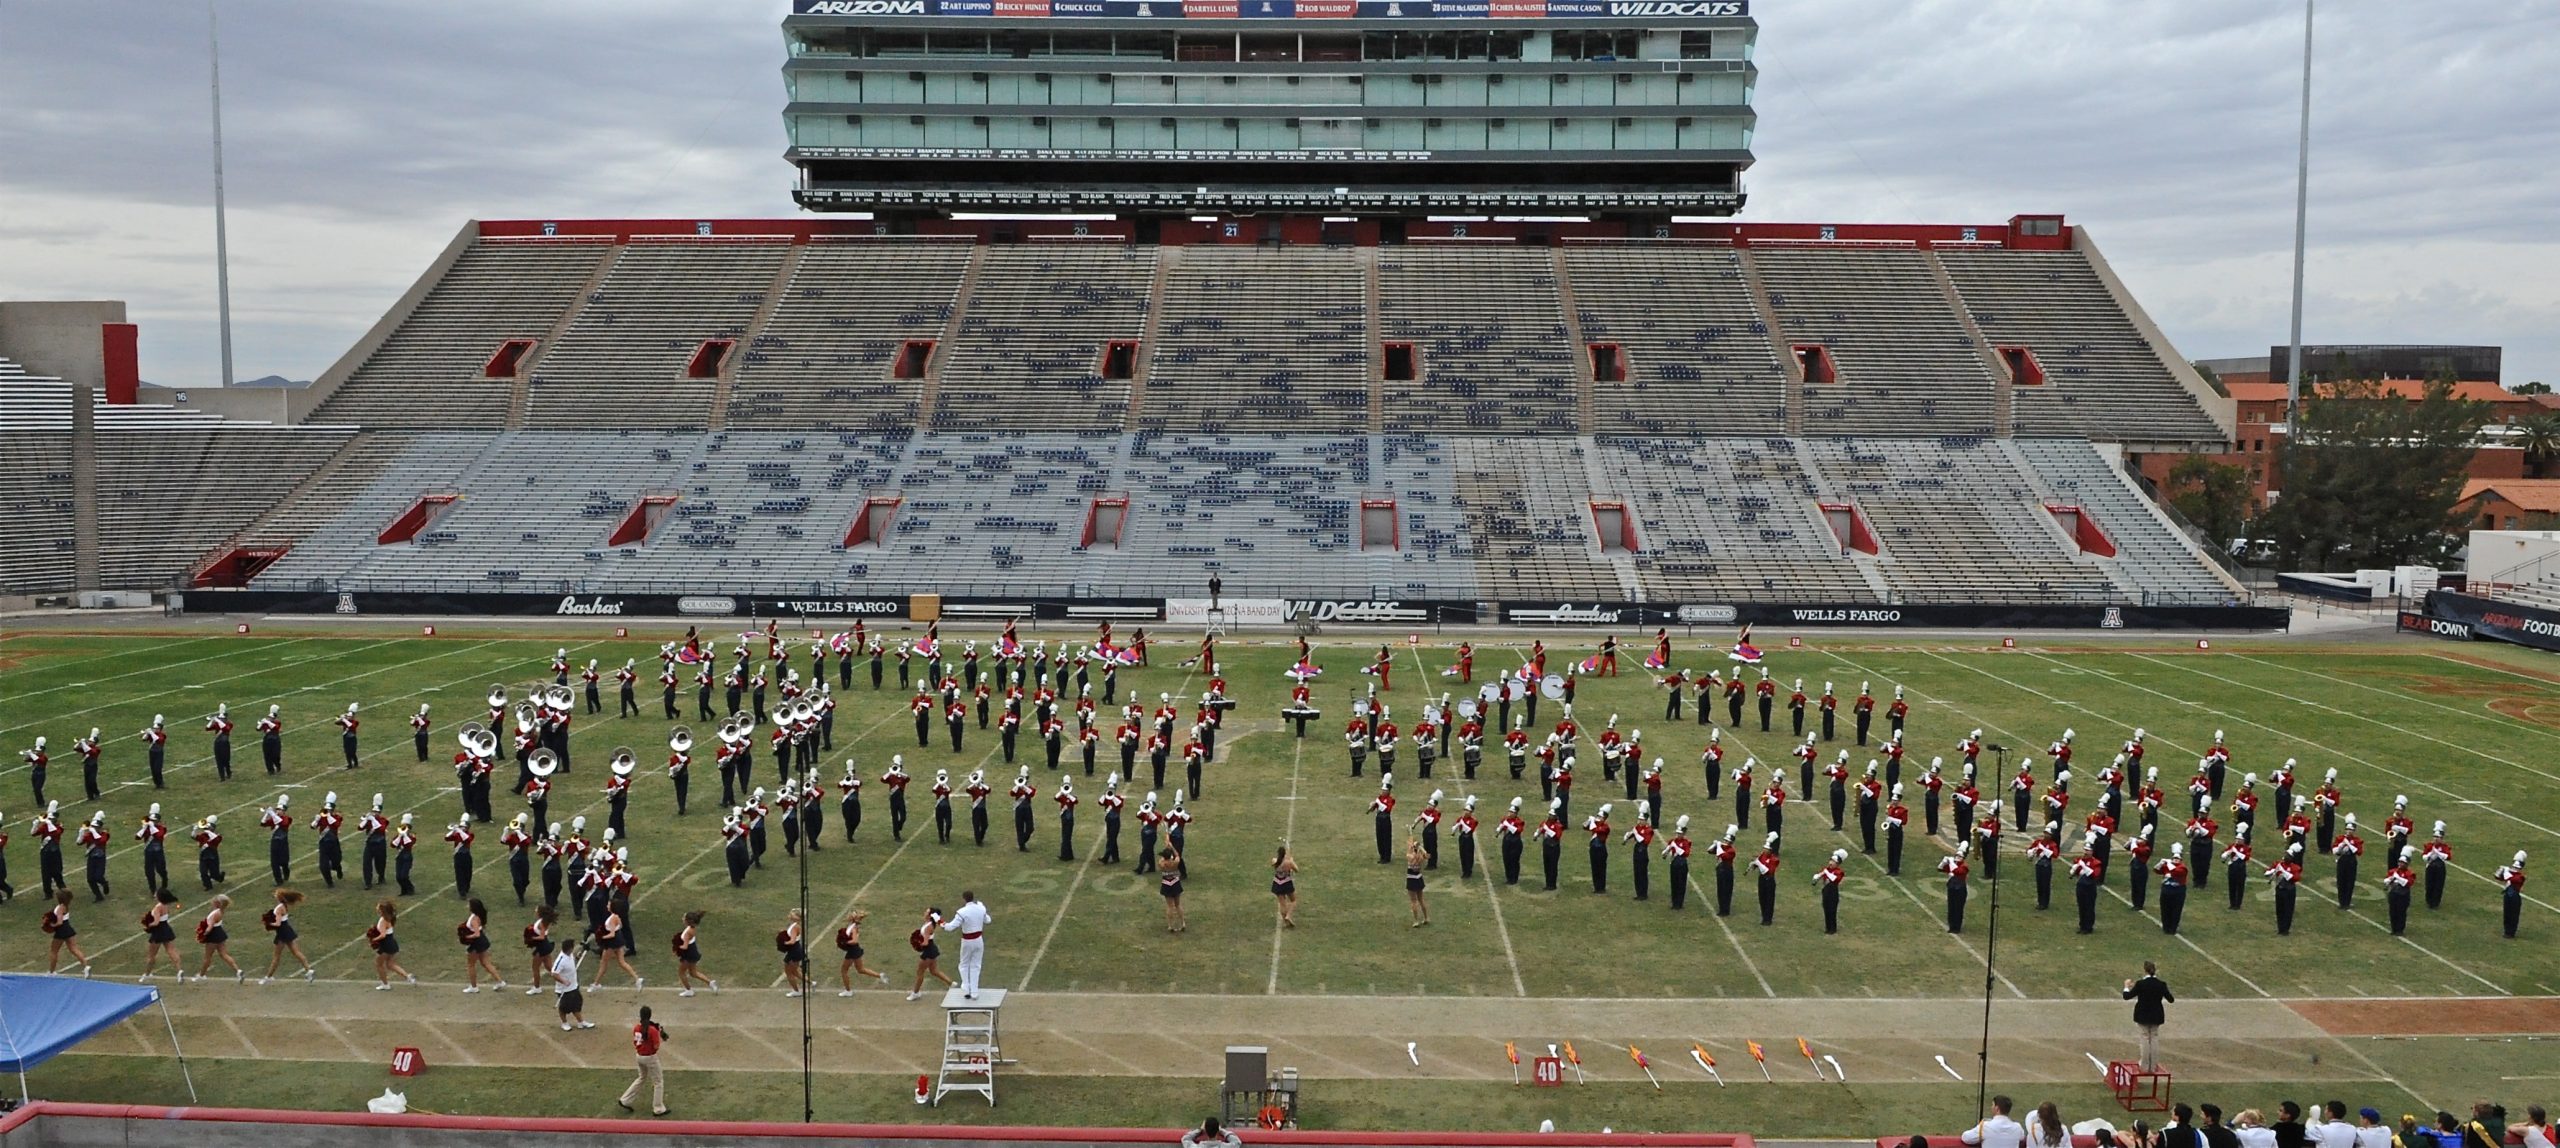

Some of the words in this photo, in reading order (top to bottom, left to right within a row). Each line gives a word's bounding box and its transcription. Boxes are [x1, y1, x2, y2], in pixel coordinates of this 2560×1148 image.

[807, 1, 925, 14] ARIZONA
[940, 2, 949, 10] 22
[1441, 4, 1456, 12] STEVE
[1552, 4, 1579, 12] ANTOINE
[1610, 2, 1741, 16] WILDCATS
[544, 227, 554, 236] 17
[698, 226, 710, 236] 18
[875, 226, 886, 235] 19
[1074, 227, 1087, 236] 20
[1225, 227, 1237, 236] 21
[1453, 228, 1466, 237] 22
[1655, 229, 1668, 238] 23
[1821, 232, 1834, 240] 24
[1963, 232, 1976, 241] 25
[176, 392, 186, 401] 16
[557, 596, 624, 614] Bashas'
[791, 602, 844, 612] WELLS
[846, 602, 898, 613] FARGO
[1169, 607, 1204, 616] UNIVERSITY
[1247, 607, 1266, 616] BAND
[1267, 607, 1281, 616] DAY
[1699, 609, 1732, 617] CASINOS
[1792, 610, 1846, 621] WELLS
[1849, 610, 1901, 621] FARGO
[2481, 612, 2524, 630] ARIZONA
[2431, 619, 2468, 638] DOWN
[393, 1051, 412, 1072] 40
[970, 1057, 985, 1073] 50
[1538, 1061, 1557, 1082] 40
